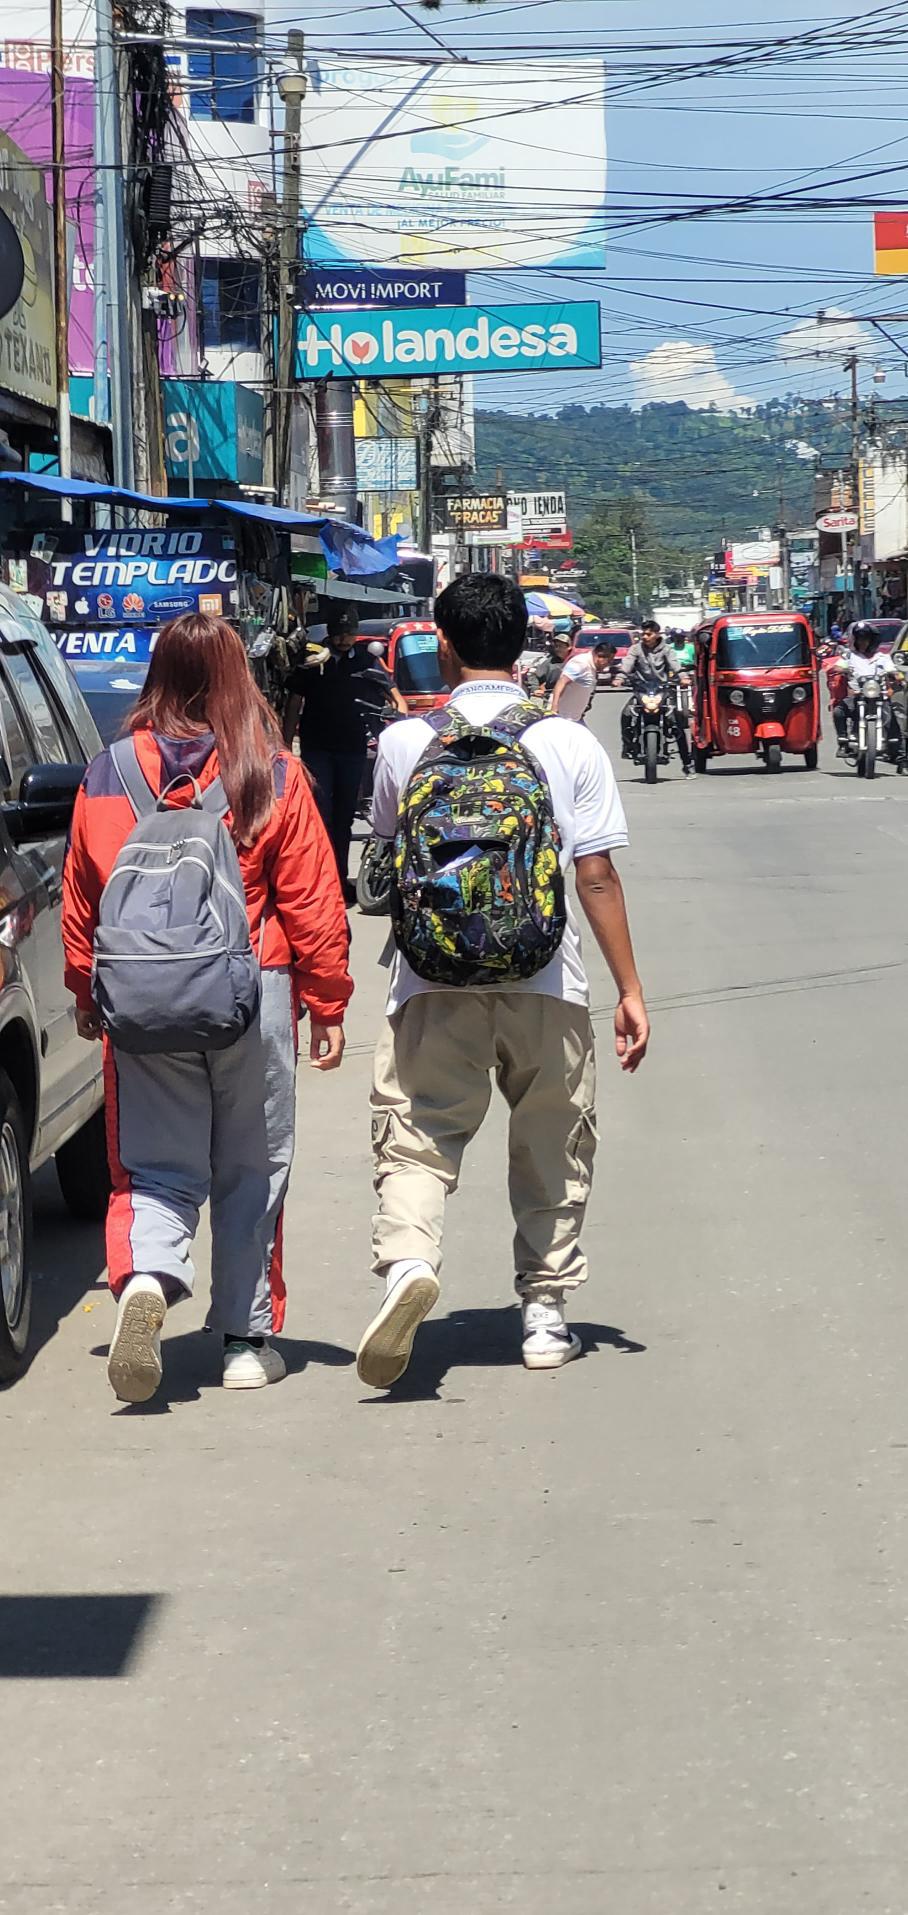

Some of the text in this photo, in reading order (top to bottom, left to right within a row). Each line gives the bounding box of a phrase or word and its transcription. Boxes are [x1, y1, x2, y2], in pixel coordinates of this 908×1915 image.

[398, 166, 505, 197] AyuFami
[462, 191, 505, 199] FAMILIAR
[315, 282, 442, 299] MOVI IMPORT
[297, 316, 578, 367] Holandesa
[447, 497, 504, 511] FARMACIA
[823, 516, 857, 529] Sarita
[84, 531, 203, 557] VIDRIO
[153, 600, 189, 609] SAMSUNG
[52, 632, 136, 654] VENTA
